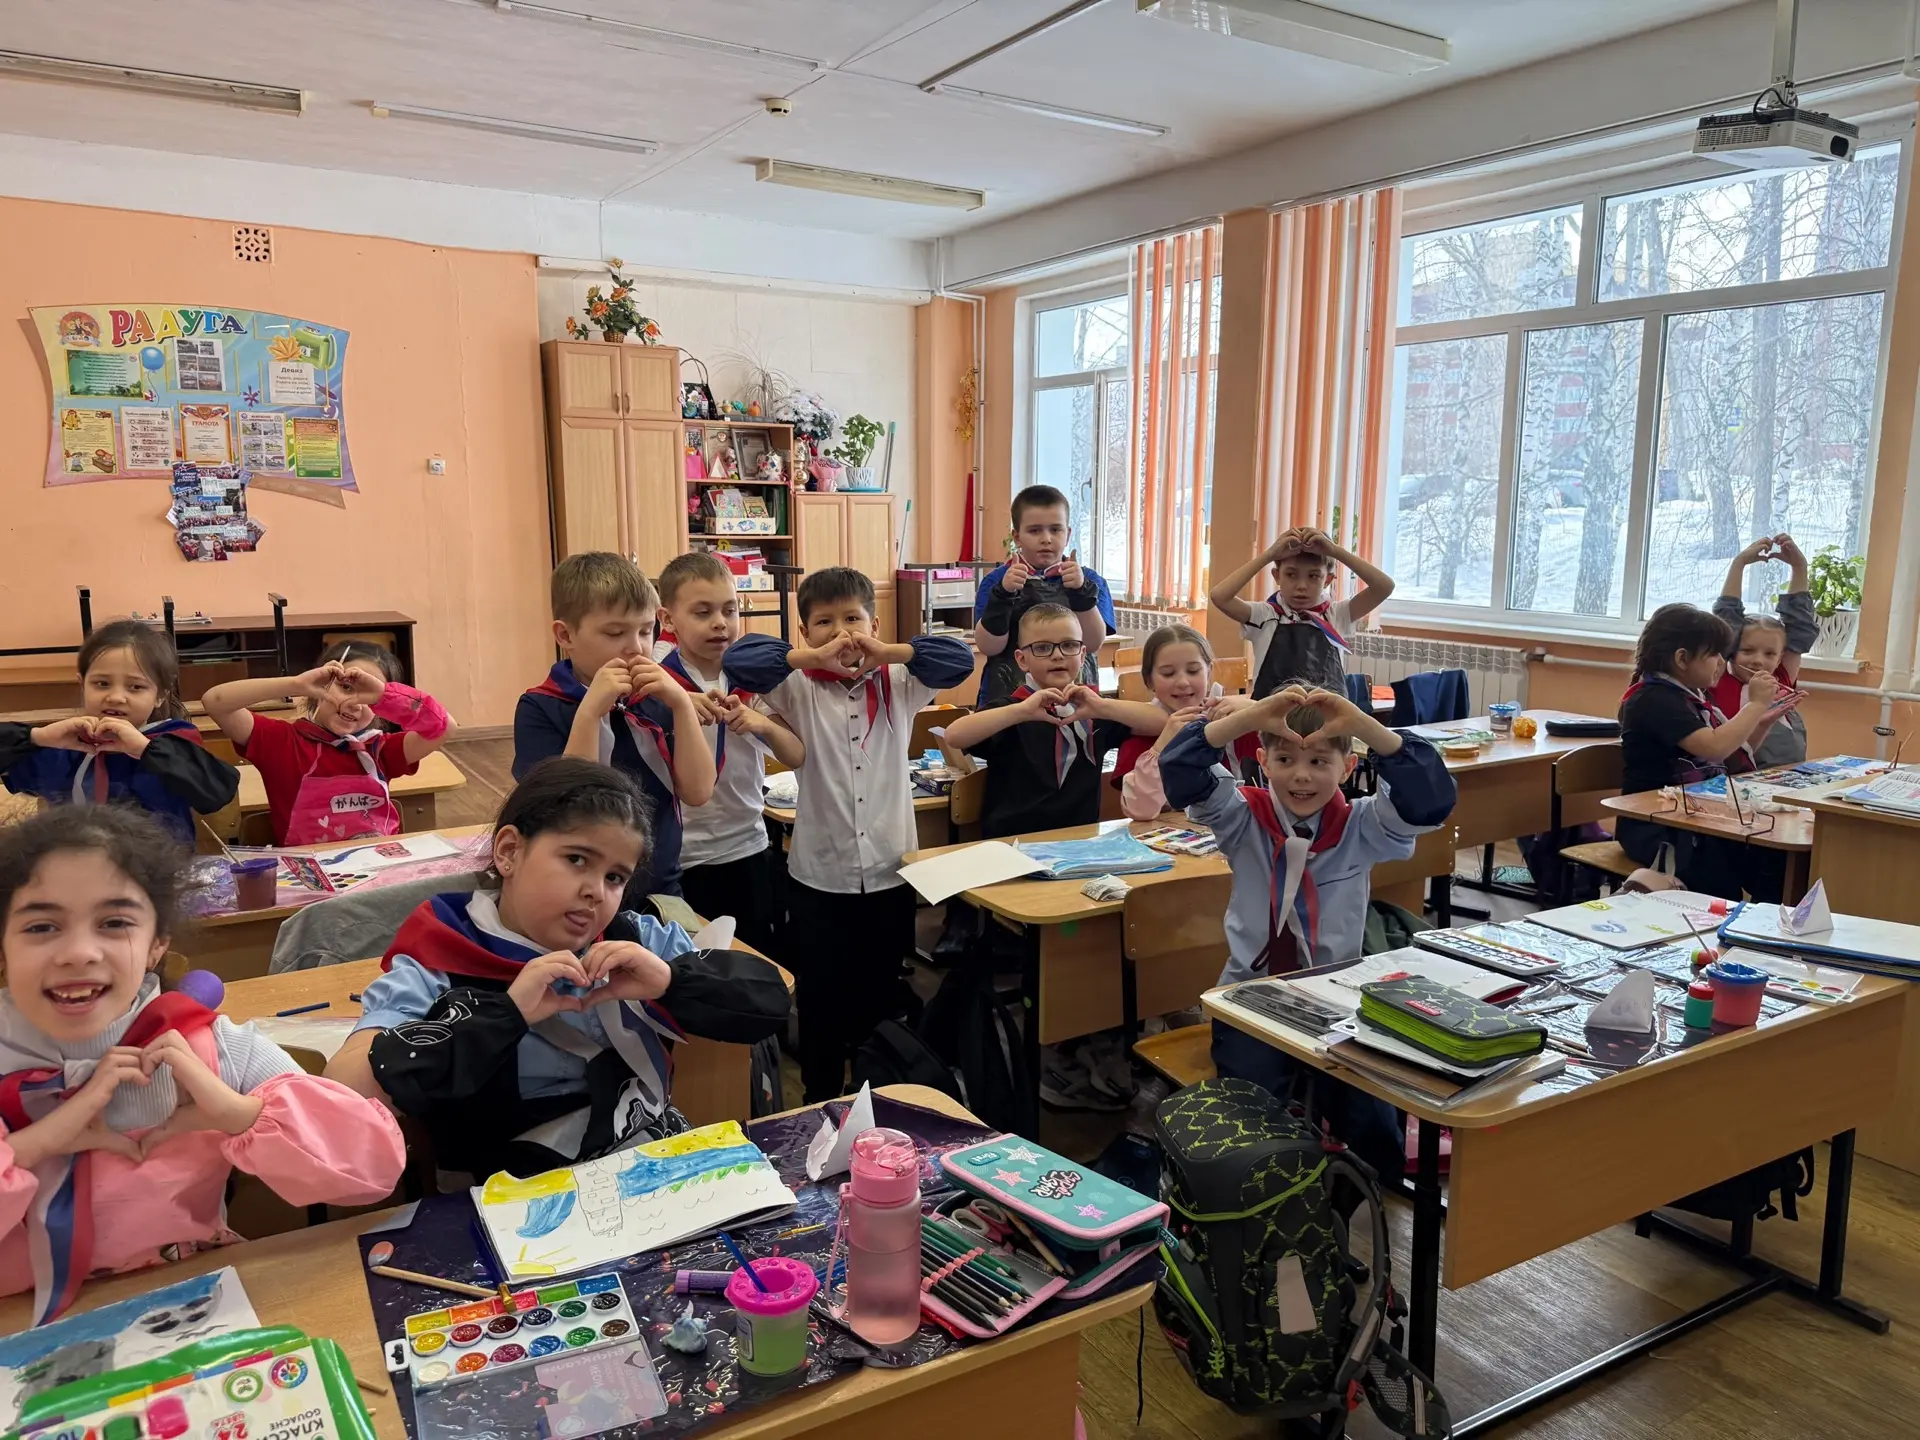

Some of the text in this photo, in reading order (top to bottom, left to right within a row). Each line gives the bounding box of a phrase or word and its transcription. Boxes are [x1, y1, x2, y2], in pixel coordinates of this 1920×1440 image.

[109, 308, 246, 347] РАДУГА
[257, 1417, 324, 1440] КЛАСС
[269, 1408, 321, 1430] GOUACHE
[217, 1422, 249, 1440] 24
